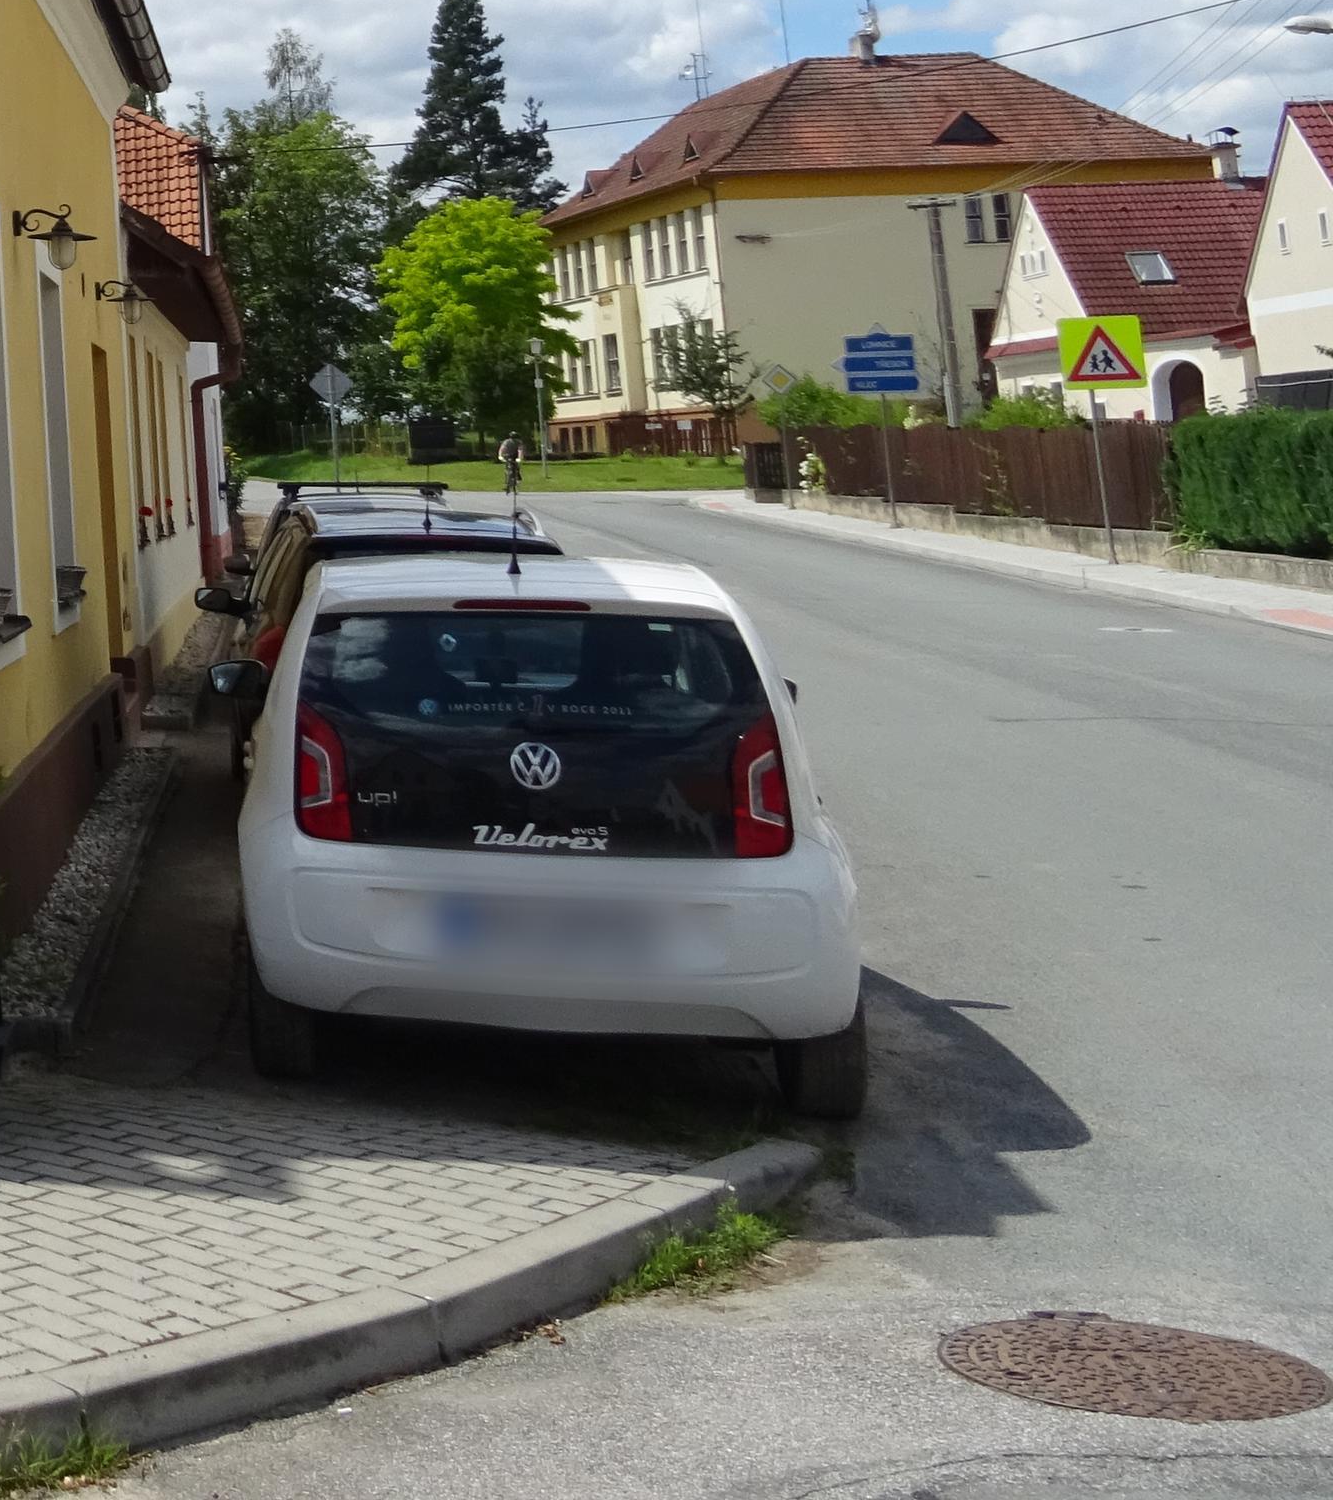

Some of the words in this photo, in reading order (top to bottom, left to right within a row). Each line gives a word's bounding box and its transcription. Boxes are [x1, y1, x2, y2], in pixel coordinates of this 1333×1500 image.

[561, 704, 597, 715] ROCE
[602, 705, 633, 716] 2011
[357, 790, 398, 807] up!
[473, 822, 609, 851] Velorex
